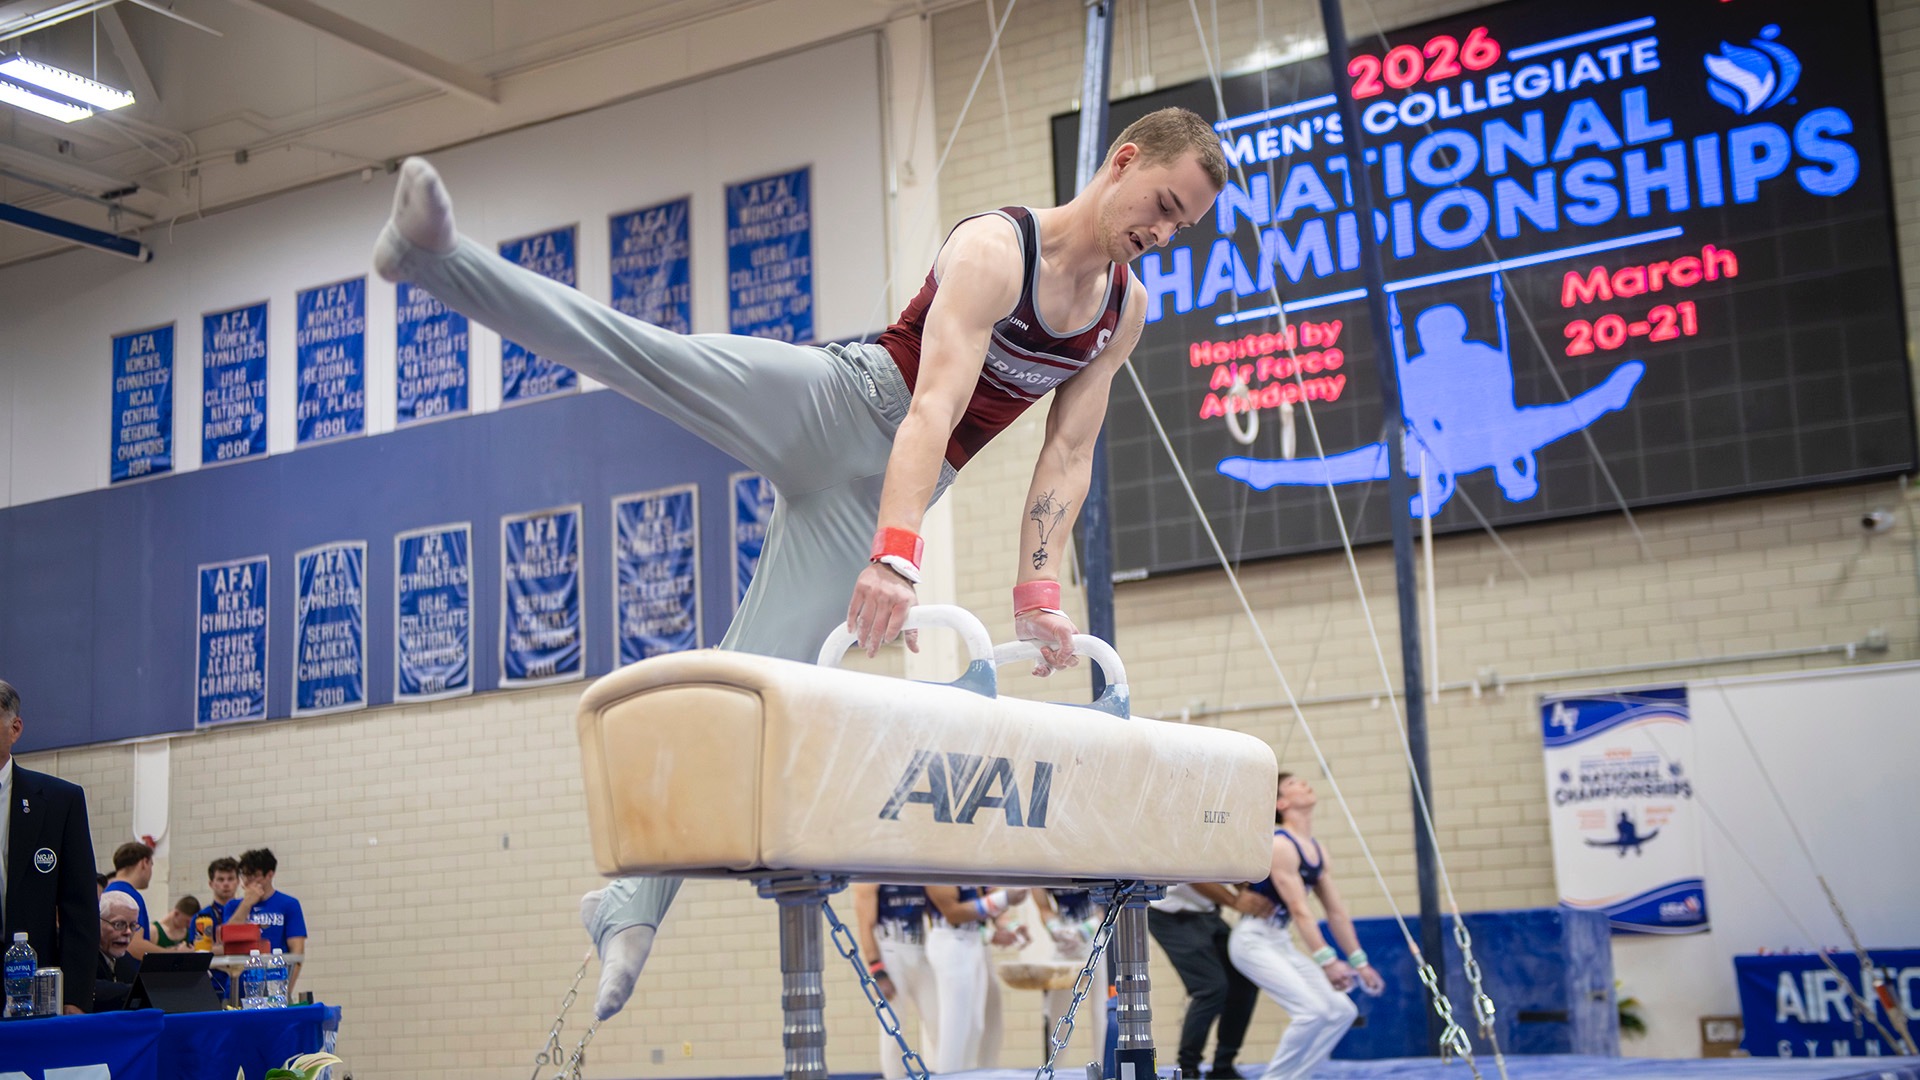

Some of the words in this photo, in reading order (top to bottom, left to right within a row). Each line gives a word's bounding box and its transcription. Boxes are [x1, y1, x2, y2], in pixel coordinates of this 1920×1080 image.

[1347, 26, 1502, 100] 2026
[1219, 111, 1345, 169] MEN'S
[1361, 36, 1662, 135] COLLEGIATE
[750, 178, 788, 204] AFA
[1136, 106, 1860, 324] HAMPIONSHIPS
[520, 234, 556, 262] AFA
[1561, 244, 1738, 308] March
[315, 284, 347, 308] AFA
[221, 310, 250, 333] AFA
[307, 301, 355, 327] WOMEN'S
[1009, 316, 1029, 331] URN
[297, 316, 363, 348] GYMNASTICS
[1300, 319, 1343, 348] by
[1564, 301, 1698, 356] 20-21
[130, 334, 155, 356] AFA
[205, 341, 265, 368] GYMNASTICS
[316, 344, 345, 365] NCAA
[398, 332, 467, 364] COLLEGIATE
[126, 352, 161, 372] WOMEN'S
[303, 359, 357, 385] REGIONAL
[404, 352, 462, 379] NATIONAL
[1256, 347, 1344, 382] Force
[116, 366, 169, 393] GYMNASTICS
[221, 367, 246, 388] USAG
[317, 378, 346, 399] TEAM
[400, 367, 465, 398] CHAMPIONS
[130, 389, 154, 407] NCAA
[205, 379, 265, 407] COLLEGIATE
[327, 390, 363, 414] PLACE
[122, 405, 160, 427] CENTRAL
[211, 399, 258, 422] NATIONAL
[415, 396, 449, 419] 2001
[120, 422, 161, 443] REGIONAL
[205, 418, 242, 440] RUNNER
[250, 413, 264, 431] UP
[314, 417, 346, 439] 2001
[118, 438, 164, 461] CHAMPIONS
[217, 439, 250, 459] 2000
[422, 532, 444, 553] AFA
[524, 516, 558, 544] AFA
[315, 549, 345, 574] AFA
[417, 551, 450, 573] MEN'S
[214, 565, 253, 594] AFA
[400, 567, 468, 593] GYMNASTICS
[217, 590, 250, 612] MEN'S
[418, 593, 448, 615] USAG
[201, 606, 265, 634] GYMNASTICS
[306, 621, 352, 644] SERVICE
[400, 608, 468, 635] COLLEGIATE
[209, 632, 255, 657] SERVICE
[304, 638, 353, 662] ACADEMY
[207, 652, 257, 677] ACADEMY
[299, 656, 359, 682] CHAMPIONS
[201, 670, 262, 697] CHAMPIONS
[210, 696, 251, 720] 2000
[313, 686, 345, 708] 2010
[1776, 969, 1853, 1024] AIR
